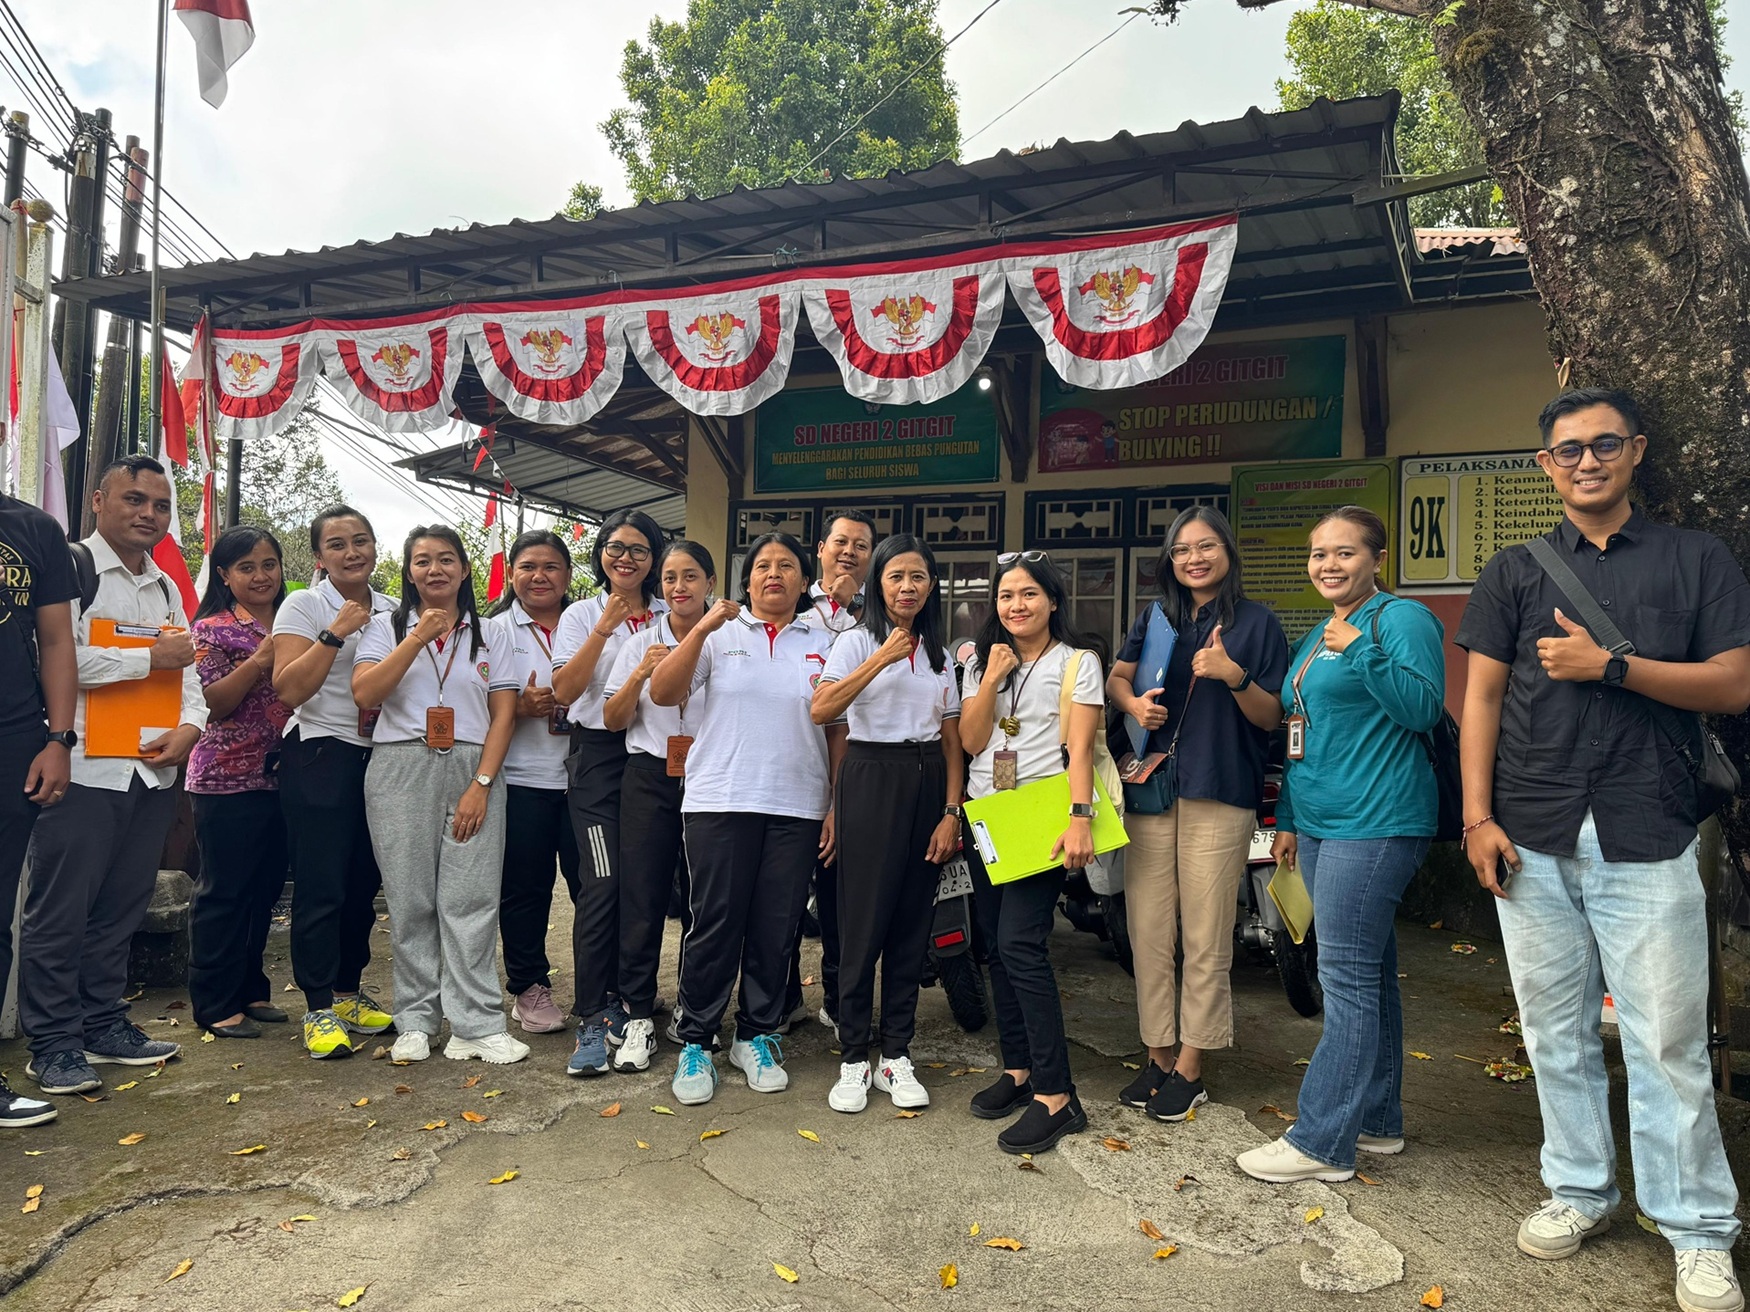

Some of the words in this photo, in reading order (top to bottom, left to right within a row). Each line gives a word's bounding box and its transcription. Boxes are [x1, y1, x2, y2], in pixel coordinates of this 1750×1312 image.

[1196, 361, 1211, 384] 2
[1214, 355, 1289, 384] GITGIT
[1118, 405, 1170, 431] STOP
[1175, 397, 1317, 427] PERUDUNGAN
[1323, 395, 1334, 418] /
[794, 424, 817, 446] SD
[820, 420, 879, 444] NEGERI
[881, 419, 893, 440] 2
[896, 415, 957, 439] GITGIT
[772, 448, 852, 465] MENYELENGGARAKAN
[854, 445, 904, 461] PENDIDIKAN
[905, 443, 932, 458] BEBAS
[934, 440, 980, 456] PUNGUTAN
[1118, 434, 1201, 461] BULYING
[825, 467, 847, 481] BAGI
[848, 465, 887, 479] SELURUH
[889, 463, 919, 477] SISWA
[1419, 458, 1542, 473] PELAKSANA
[1255, 482, 1269, 492] VISI
[1270, 482, 1284, 491] DAN
[1285, 481, 1300, 491] MISI
[1313, 480, 1337, 489] NEGERI
[1338, 479, 1343, 488] 2
[1344, 478, 1368, 487] GITGIT
[1477, 477, 1489, 486] 1.
[1494, 475, 1553, 485] Keaman
[1475, 487, 1488, 497] 2.
[1475, 498, 1488, 508] 3.
[1494, 496, 1563, 507] Ketertiba
[1474, 510, 1488, 519] 4.
[1494, 507, 1564, 518] Keindaha
[1410, 496, 1446, 560] 9K
[1474, 521, 1488, 530] 5.
[1474, 532, 1487, 541] 6.
[1474, 543, 1487, 553] 7.
[1474, 554, 1487, 564] 8.
[1252, 831, 1276, 844] 679
[949, 864, 968, 879] UA
